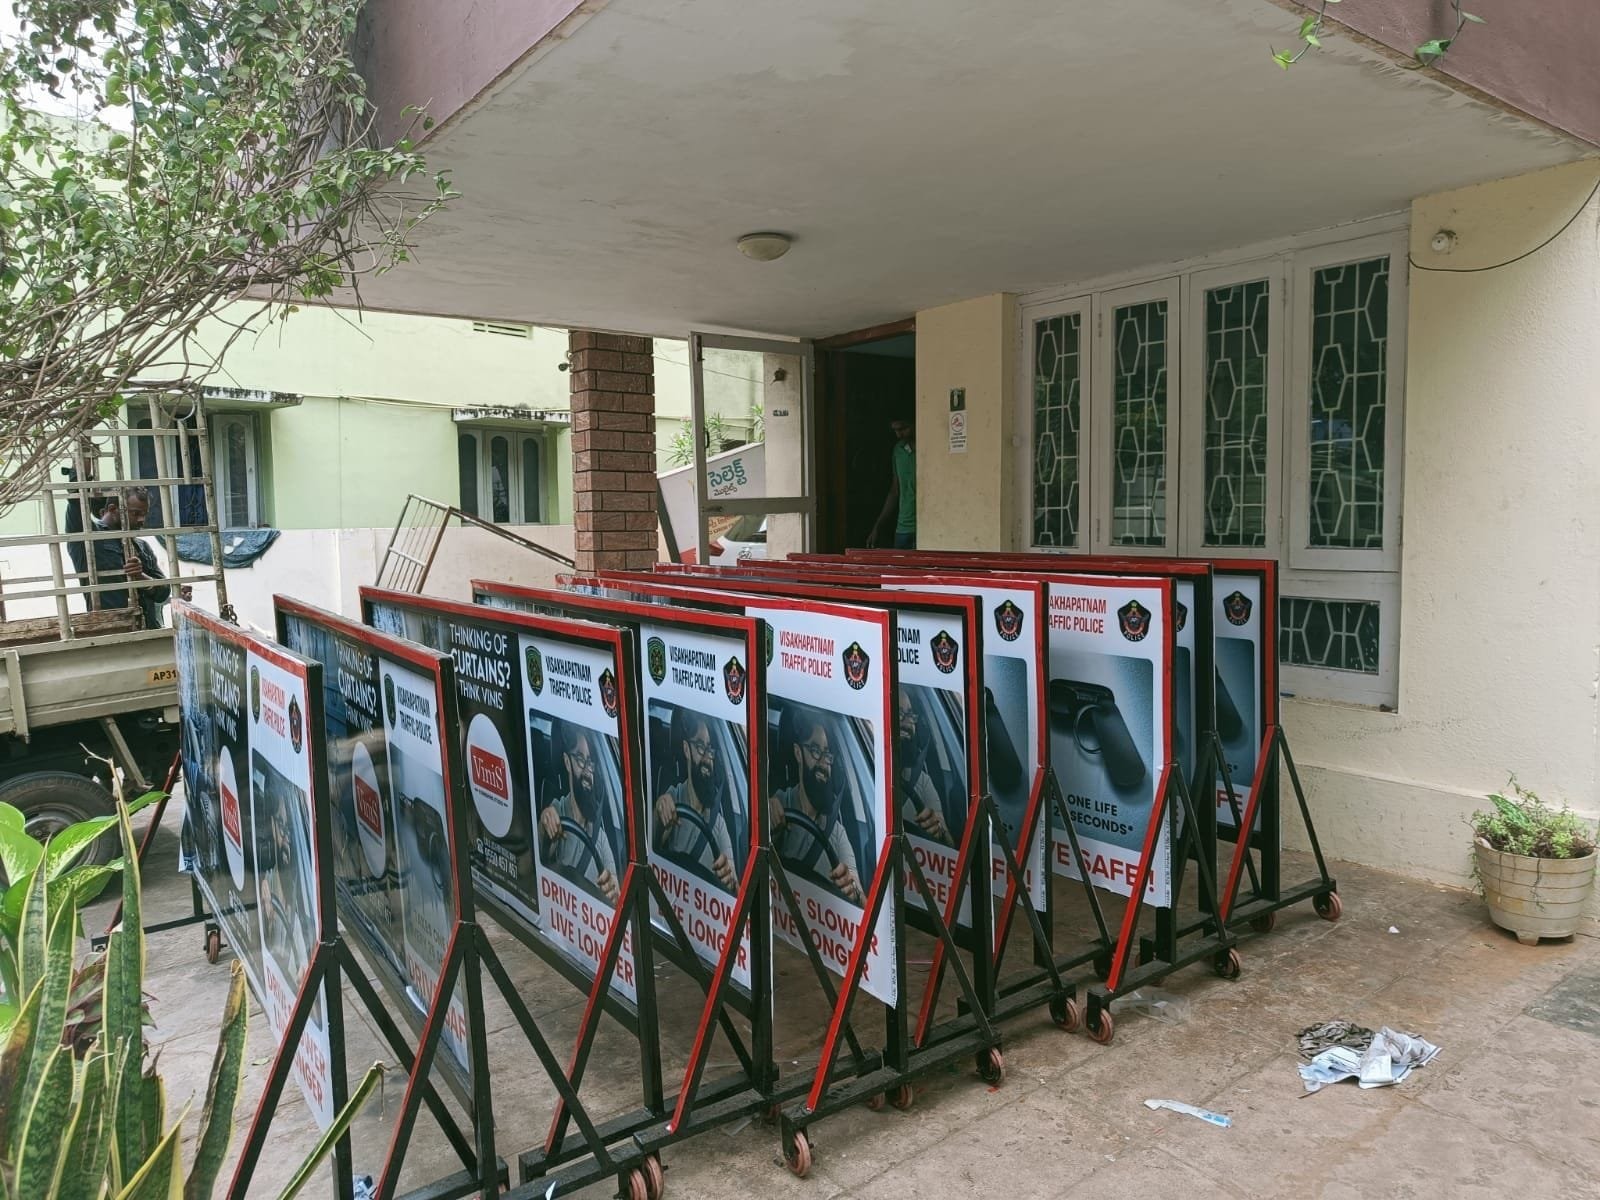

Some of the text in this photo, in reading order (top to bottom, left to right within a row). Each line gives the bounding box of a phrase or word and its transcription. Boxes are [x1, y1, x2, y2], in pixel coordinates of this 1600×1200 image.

[1049, 595, 1106, 614] AKHAPATNAM
[1049, 614, 1105, 634] AFFIC POLICE
[449, 623, 508, 656] THINKING OF
[780, 630, 834, 657] VISAKHAPATNAM
[363, 654, 373, 681] OF
[452, 647, 511, 690] CURTAINS?
[545, 655, 592, 683] VISAKHAPATNAM
[669, 645, 716, 671] VISAKHAPATNAM
[781, 652, 832, 679] TRAFFIC POLICE
[153, 670, 177, 681] AP31
[672, 667, 715, 694] TRAFFIC POLICE
[337, 667, 377, 718] CURTAINS?
[459, 679, 504, 710] THINK VINIS
[549, 677, 592, 706] TRAFFIC POLICE
[1067, 794, 1091, 809] ONE
[1095, 800, 1117, 816] LIFE
[541, 876, 578, 918] DRIVE
[652, 863, 689, 903] DRIVE
[688, 913, 746, 970] LONGR
[807, 898, 878, 957] SLOWR
[551, 907, 634, 988] LIVE LONER
[773, 906, 797, 938] IVE
[811, 928, 869, 982] ONGR
